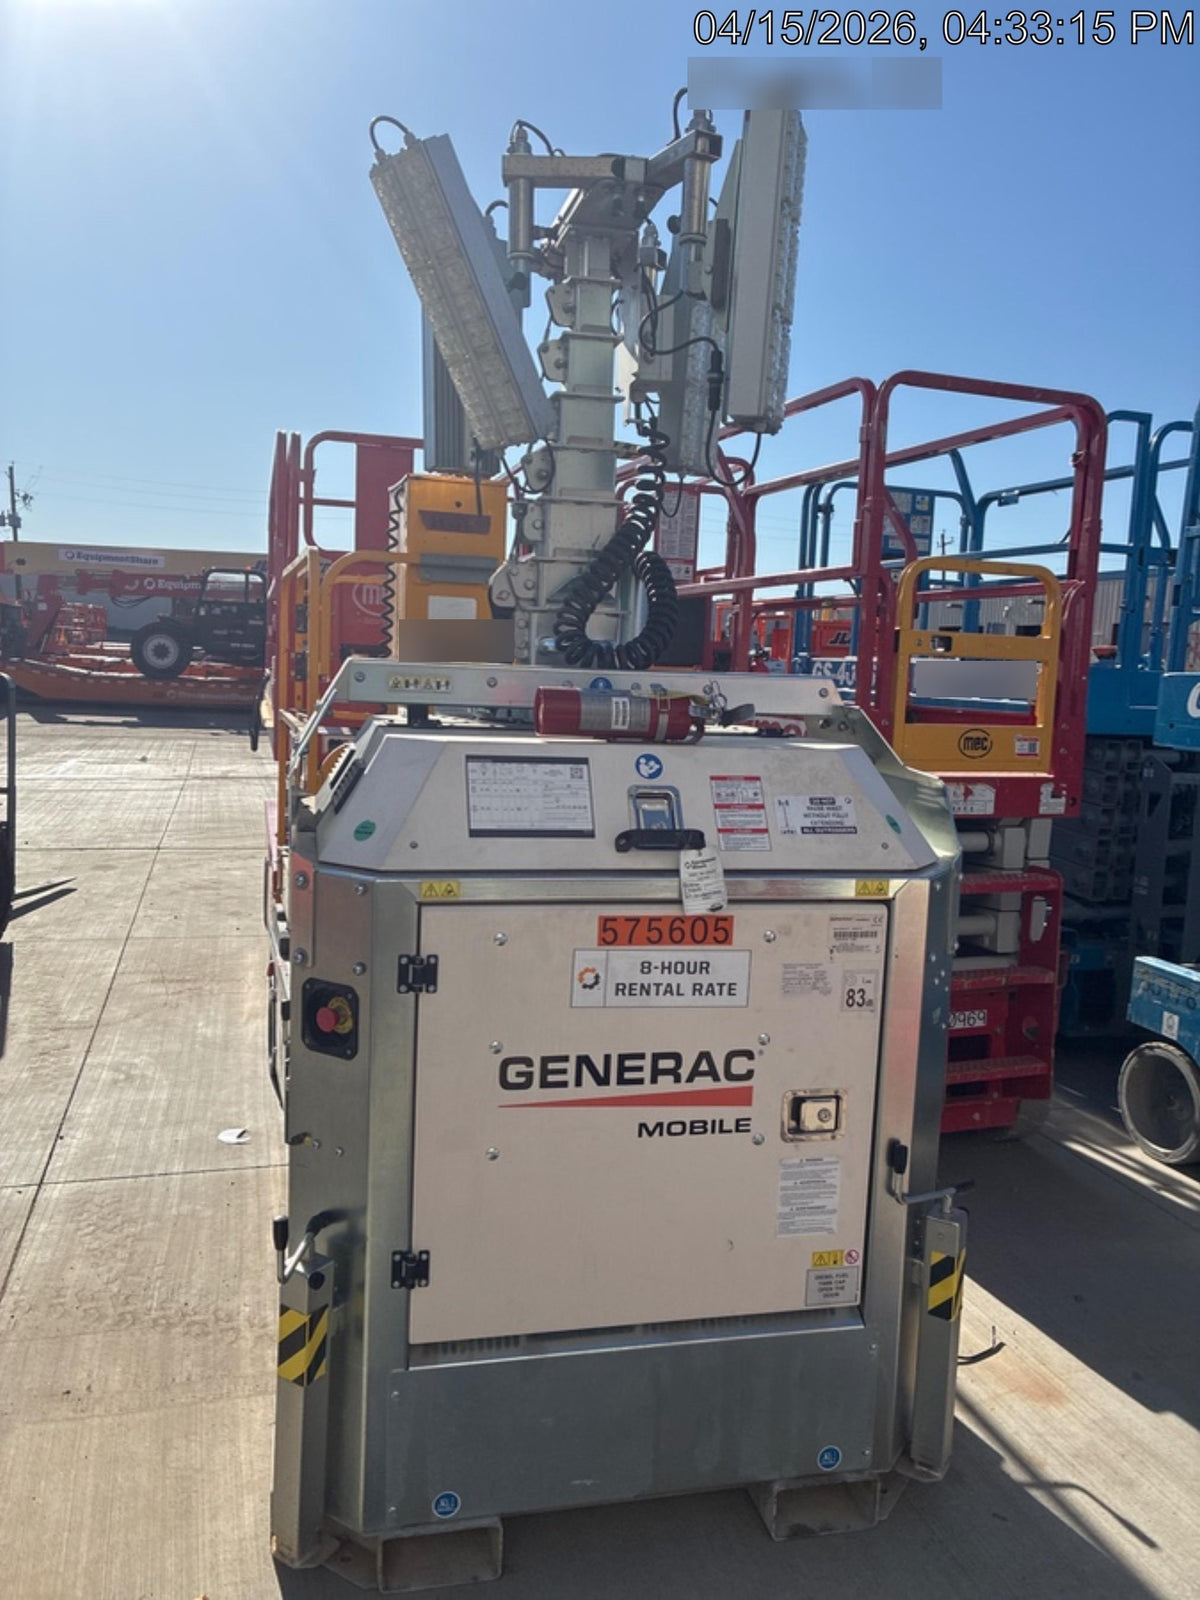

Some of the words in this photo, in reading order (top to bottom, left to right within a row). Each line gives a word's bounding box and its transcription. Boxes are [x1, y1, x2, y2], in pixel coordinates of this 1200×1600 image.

[76, 551, 159, 566] EquipmentShare
[829, 632, 850, 645] JL
[963, 736, 988, 751] mec
[601, 917, 730, 945] 575605
[640, 961, 711, 975] 8-HOUR
[614, 982, 685, 997] RENTAL
[691, 982, 738, 997] RATE
[845, 988, 866, 1008] 83
[499, 1049, 755, 1091] GENERAC
[637, 1117, 752, 1138] MOBILE
